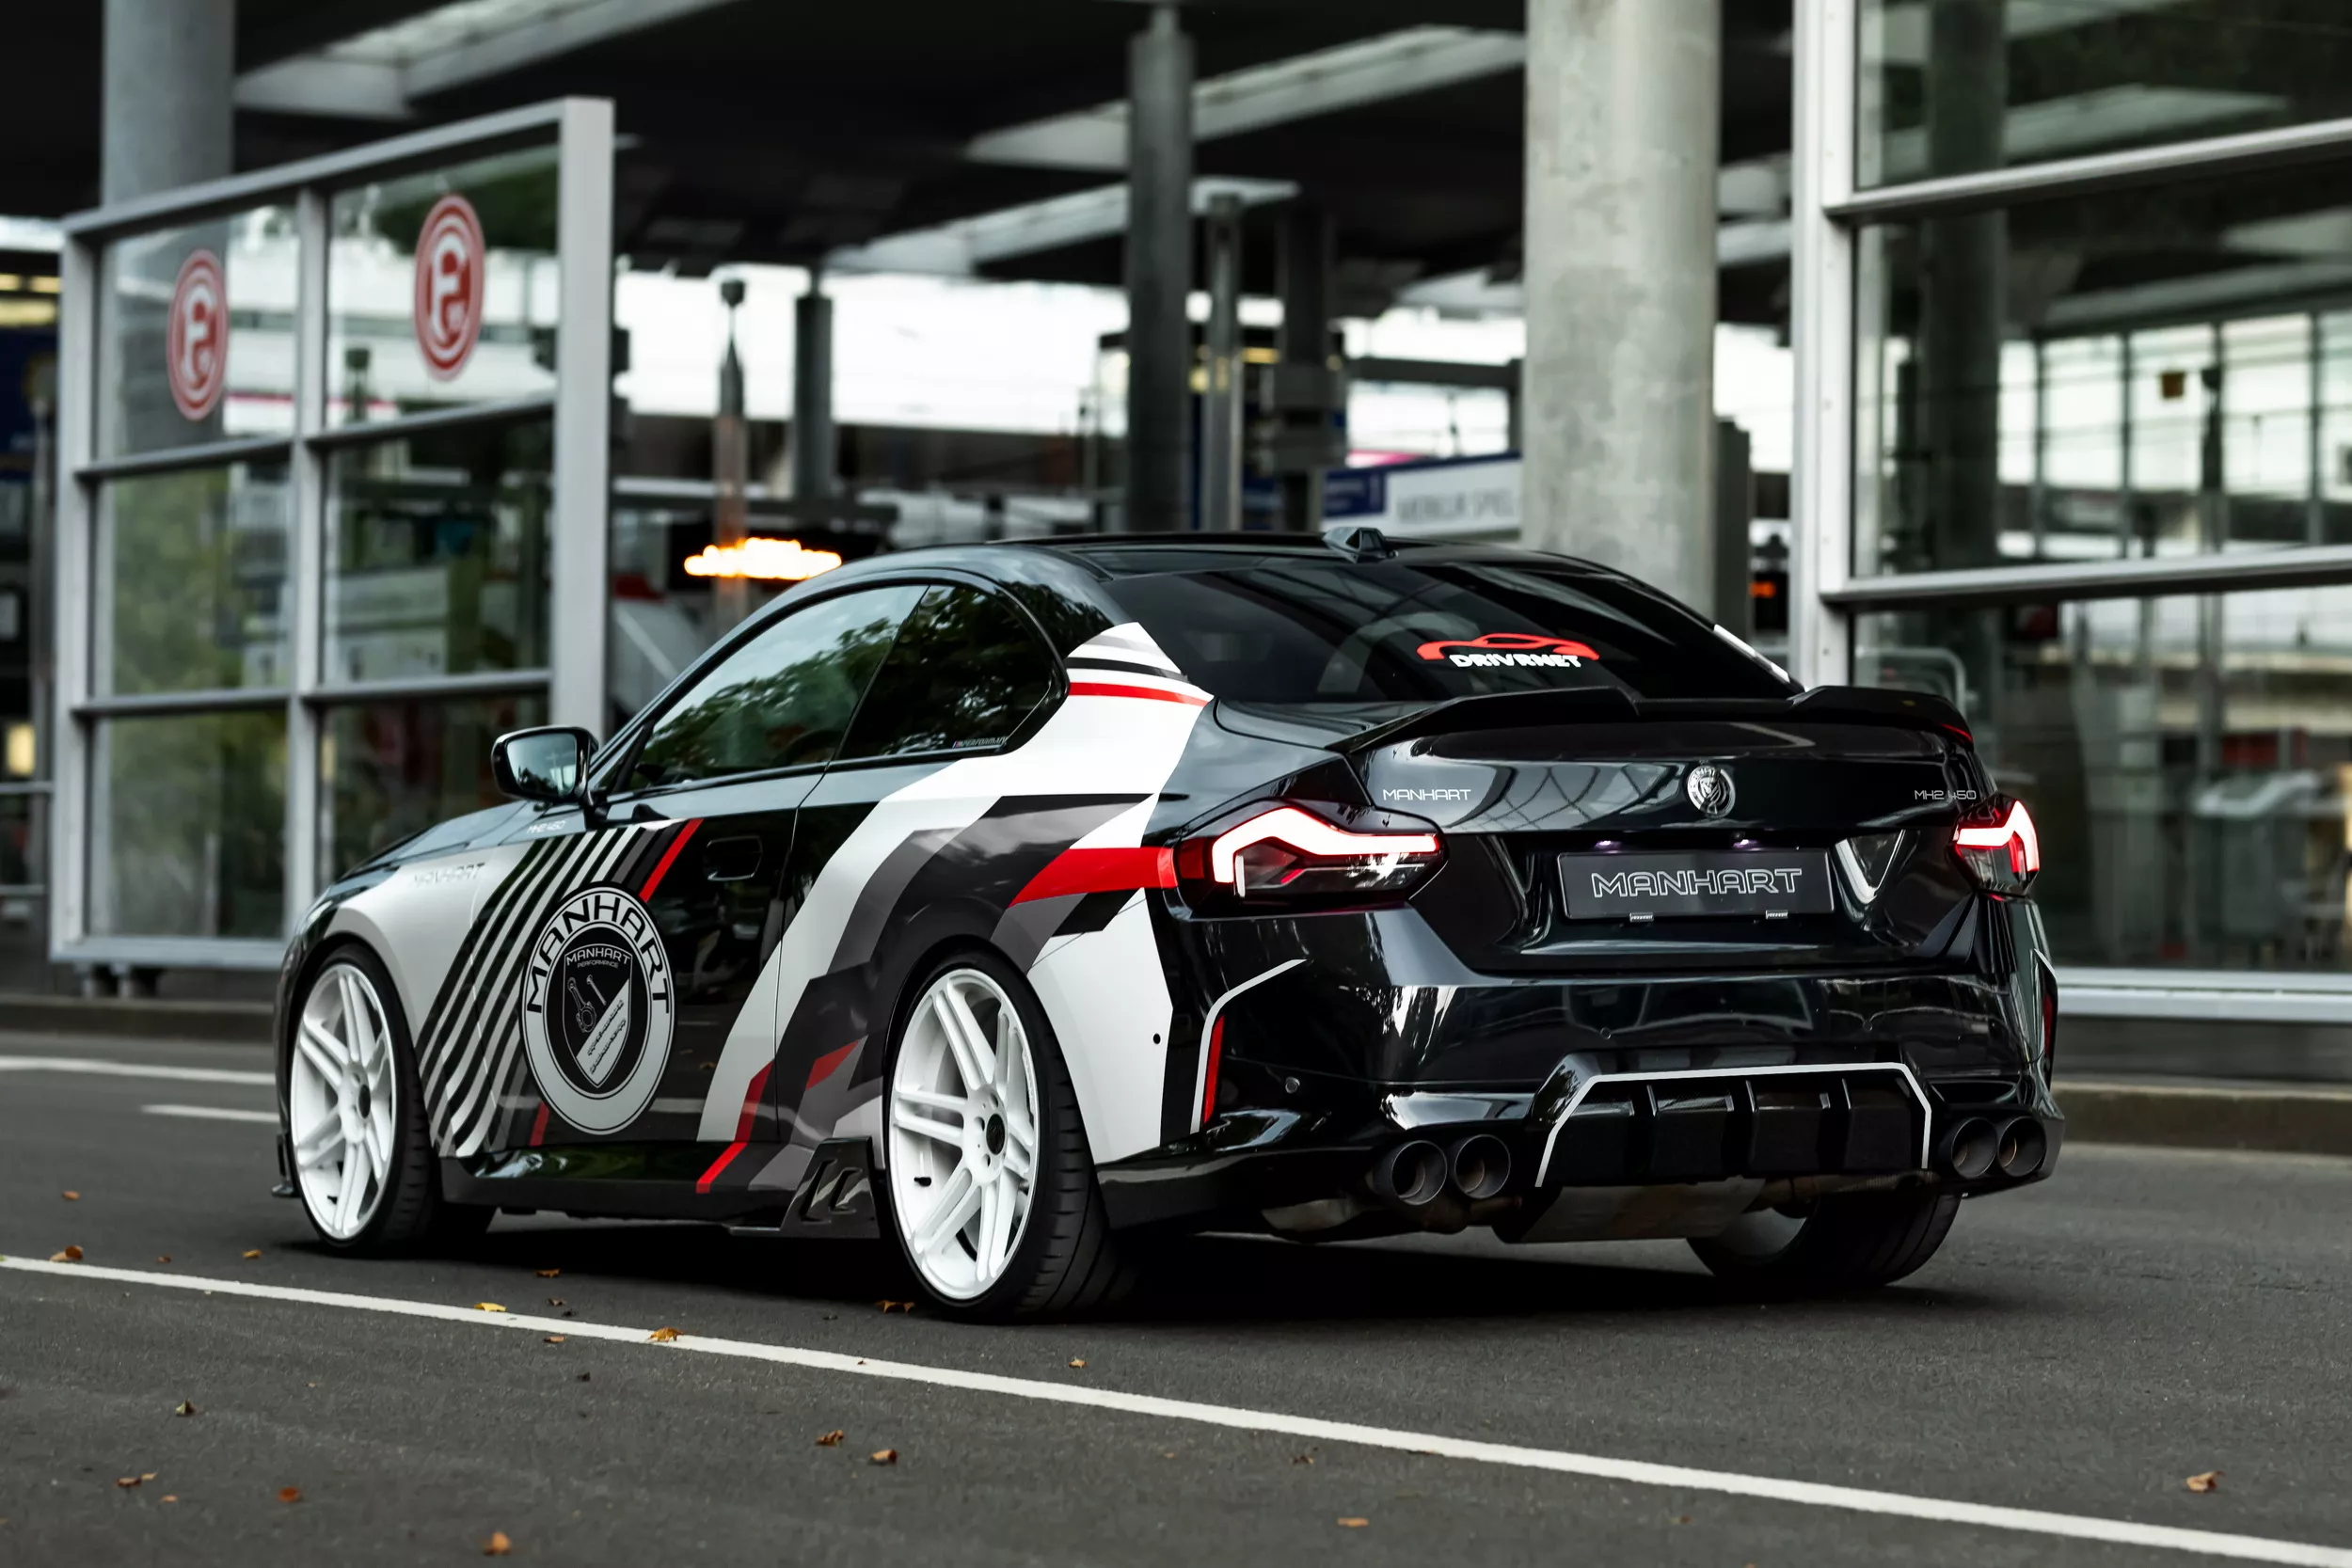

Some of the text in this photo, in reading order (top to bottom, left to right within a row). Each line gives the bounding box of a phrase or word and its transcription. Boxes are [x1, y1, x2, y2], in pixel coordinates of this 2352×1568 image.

[1449, 654, 1581, 668] DRIVRNET
[1382, 788, 1471, 800] MANHART
[1914, 789, 1977, 800] MH2 450
[1591, 867, 1803, 898] MANHART
[527, 895, 670, 1014] MANHART
[566, 947, 631, 967] MANHART
[577, 958, 619, 969] PERFORMANCE
